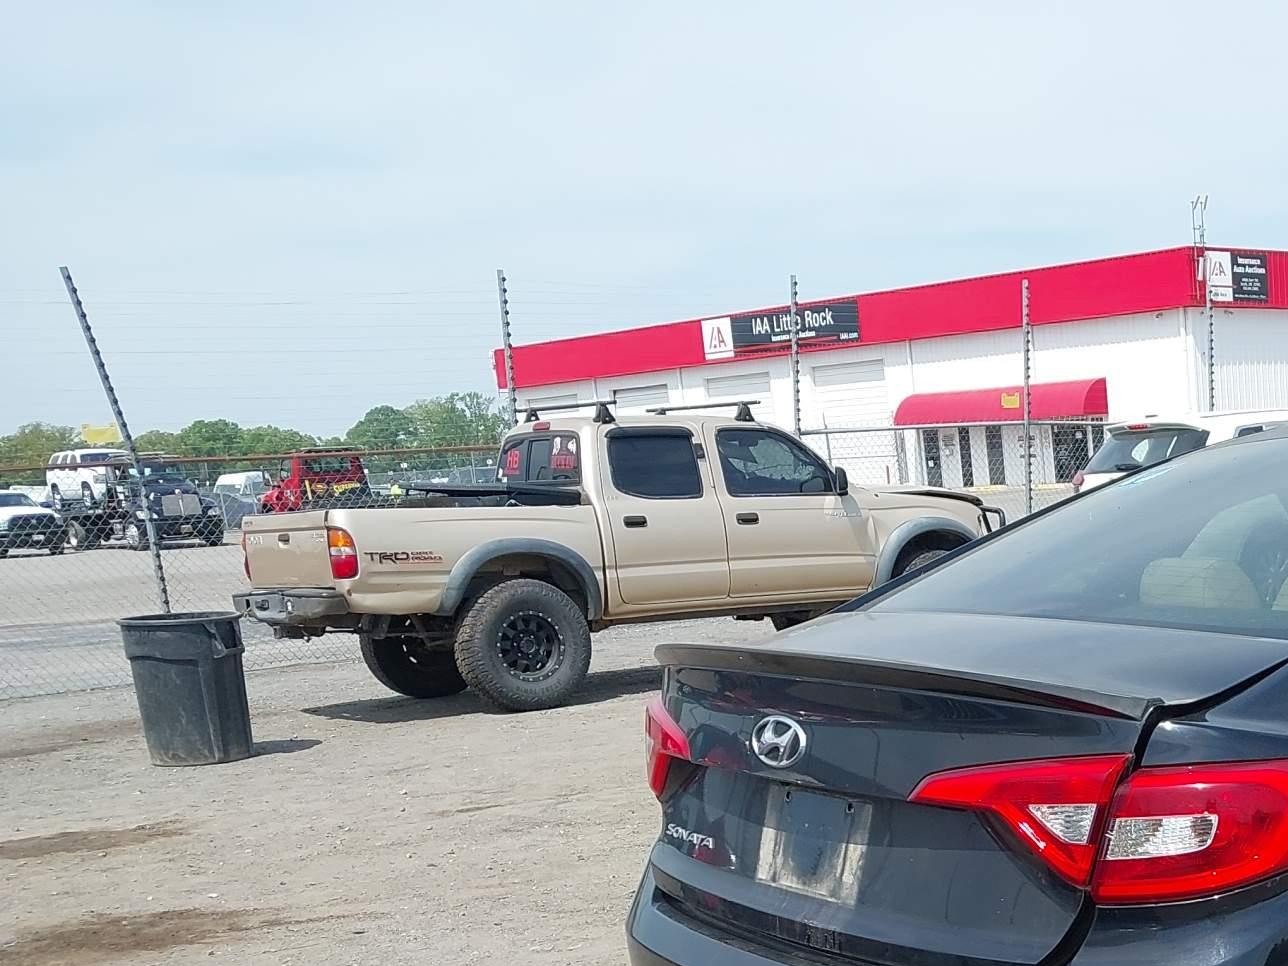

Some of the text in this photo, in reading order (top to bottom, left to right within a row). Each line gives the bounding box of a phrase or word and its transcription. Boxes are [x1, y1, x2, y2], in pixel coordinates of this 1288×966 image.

[751, 316, 771, 336] IAA
[804, 308, 834, 328] Rock
[364, 552, 409, 564] TRD
[666, 823, 713, 849] SONATA
